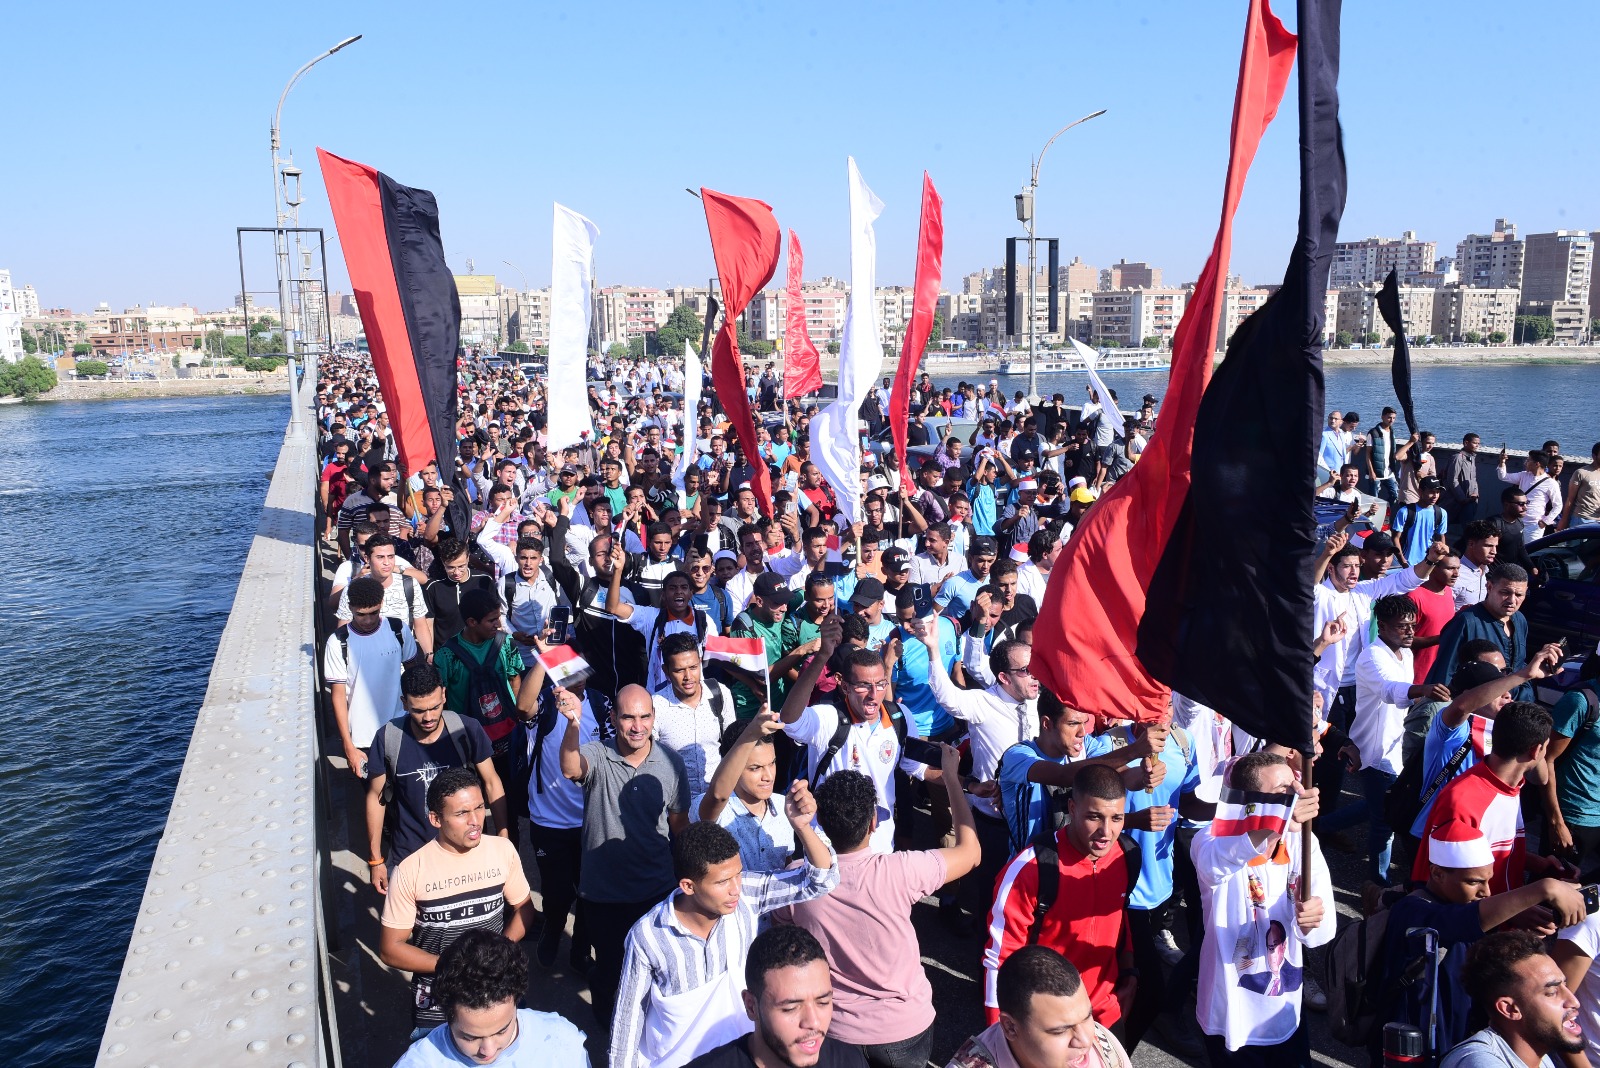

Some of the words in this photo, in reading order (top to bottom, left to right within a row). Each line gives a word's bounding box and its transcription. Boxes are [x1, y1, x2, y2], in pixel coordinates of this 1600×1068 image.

[894, 553, 910, 562] FILA
[1450, 746, 1467, 765] PUMA
[460, 906, 474, 917] JE
[484, 898, 503, 912] WEA
